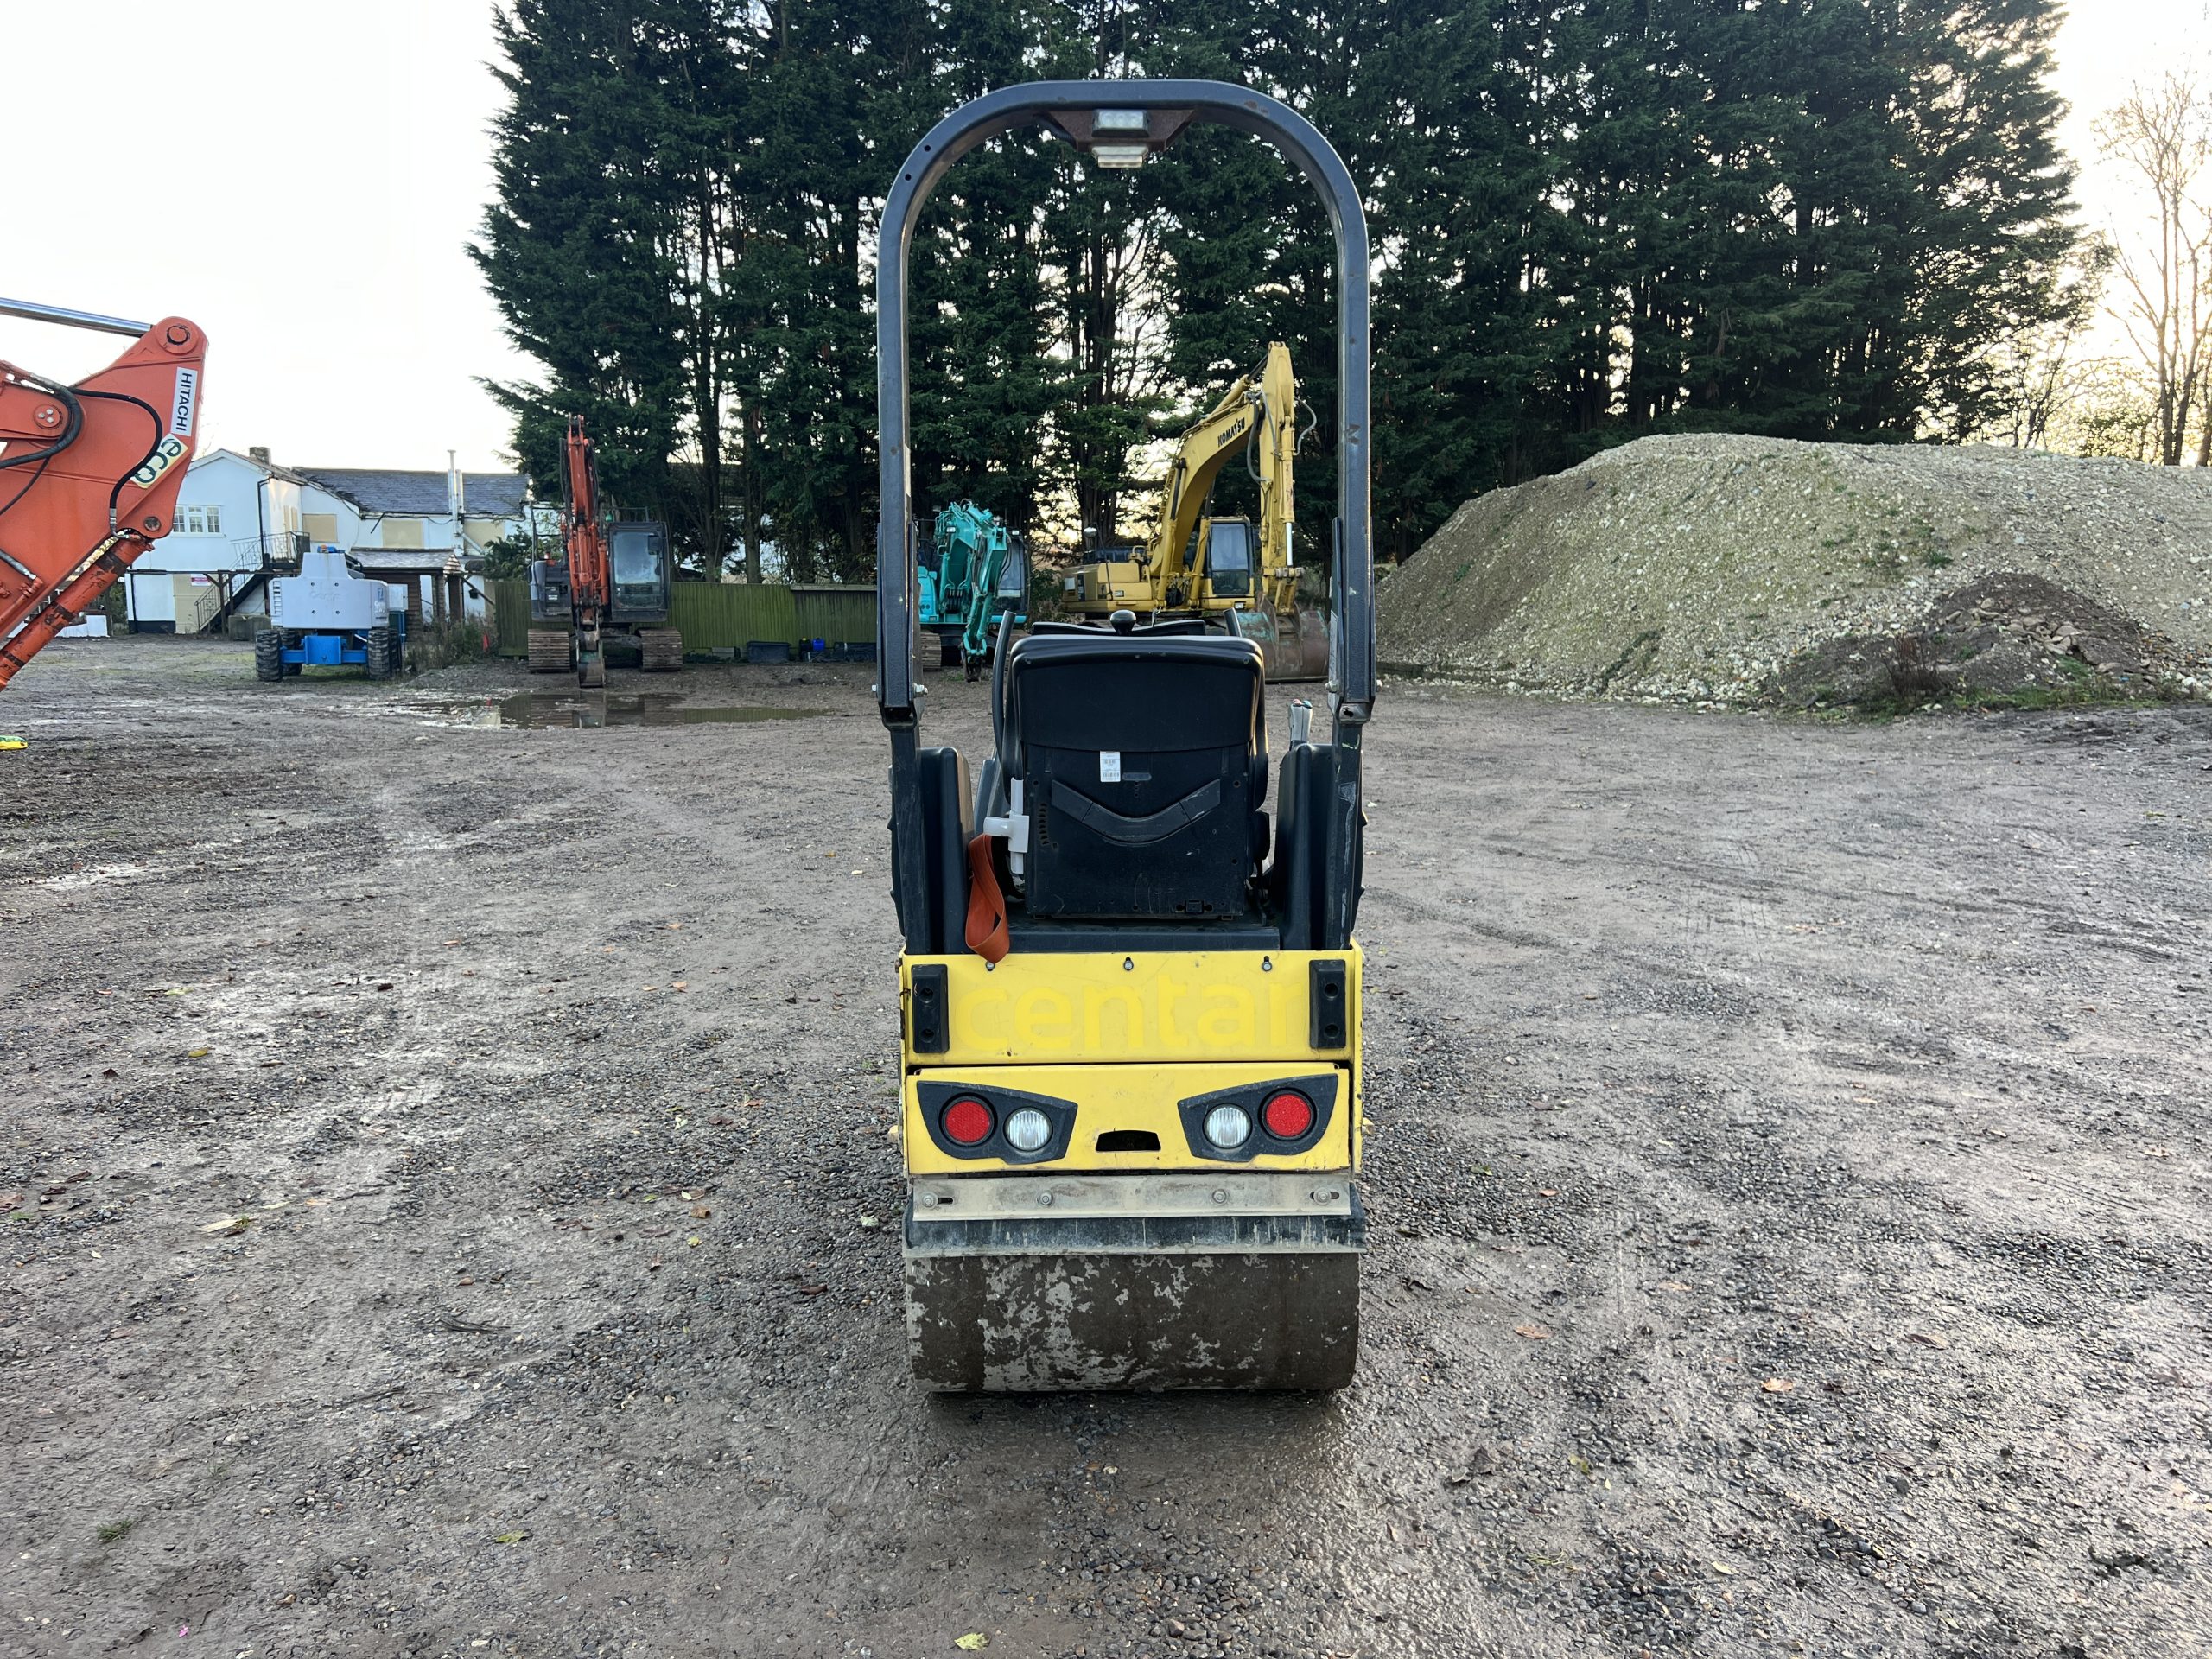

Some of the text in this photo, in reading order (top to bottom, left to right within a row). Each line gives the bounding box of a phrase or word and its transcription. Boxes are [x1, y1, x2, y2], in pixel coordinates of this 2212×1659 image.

[175, 372, 193, 432] HITACHI
[1217, 417, 1245, 448] KOMATSU
[133, 438, 182, 484] eco
[955, 974, 1302, 1051] centar
